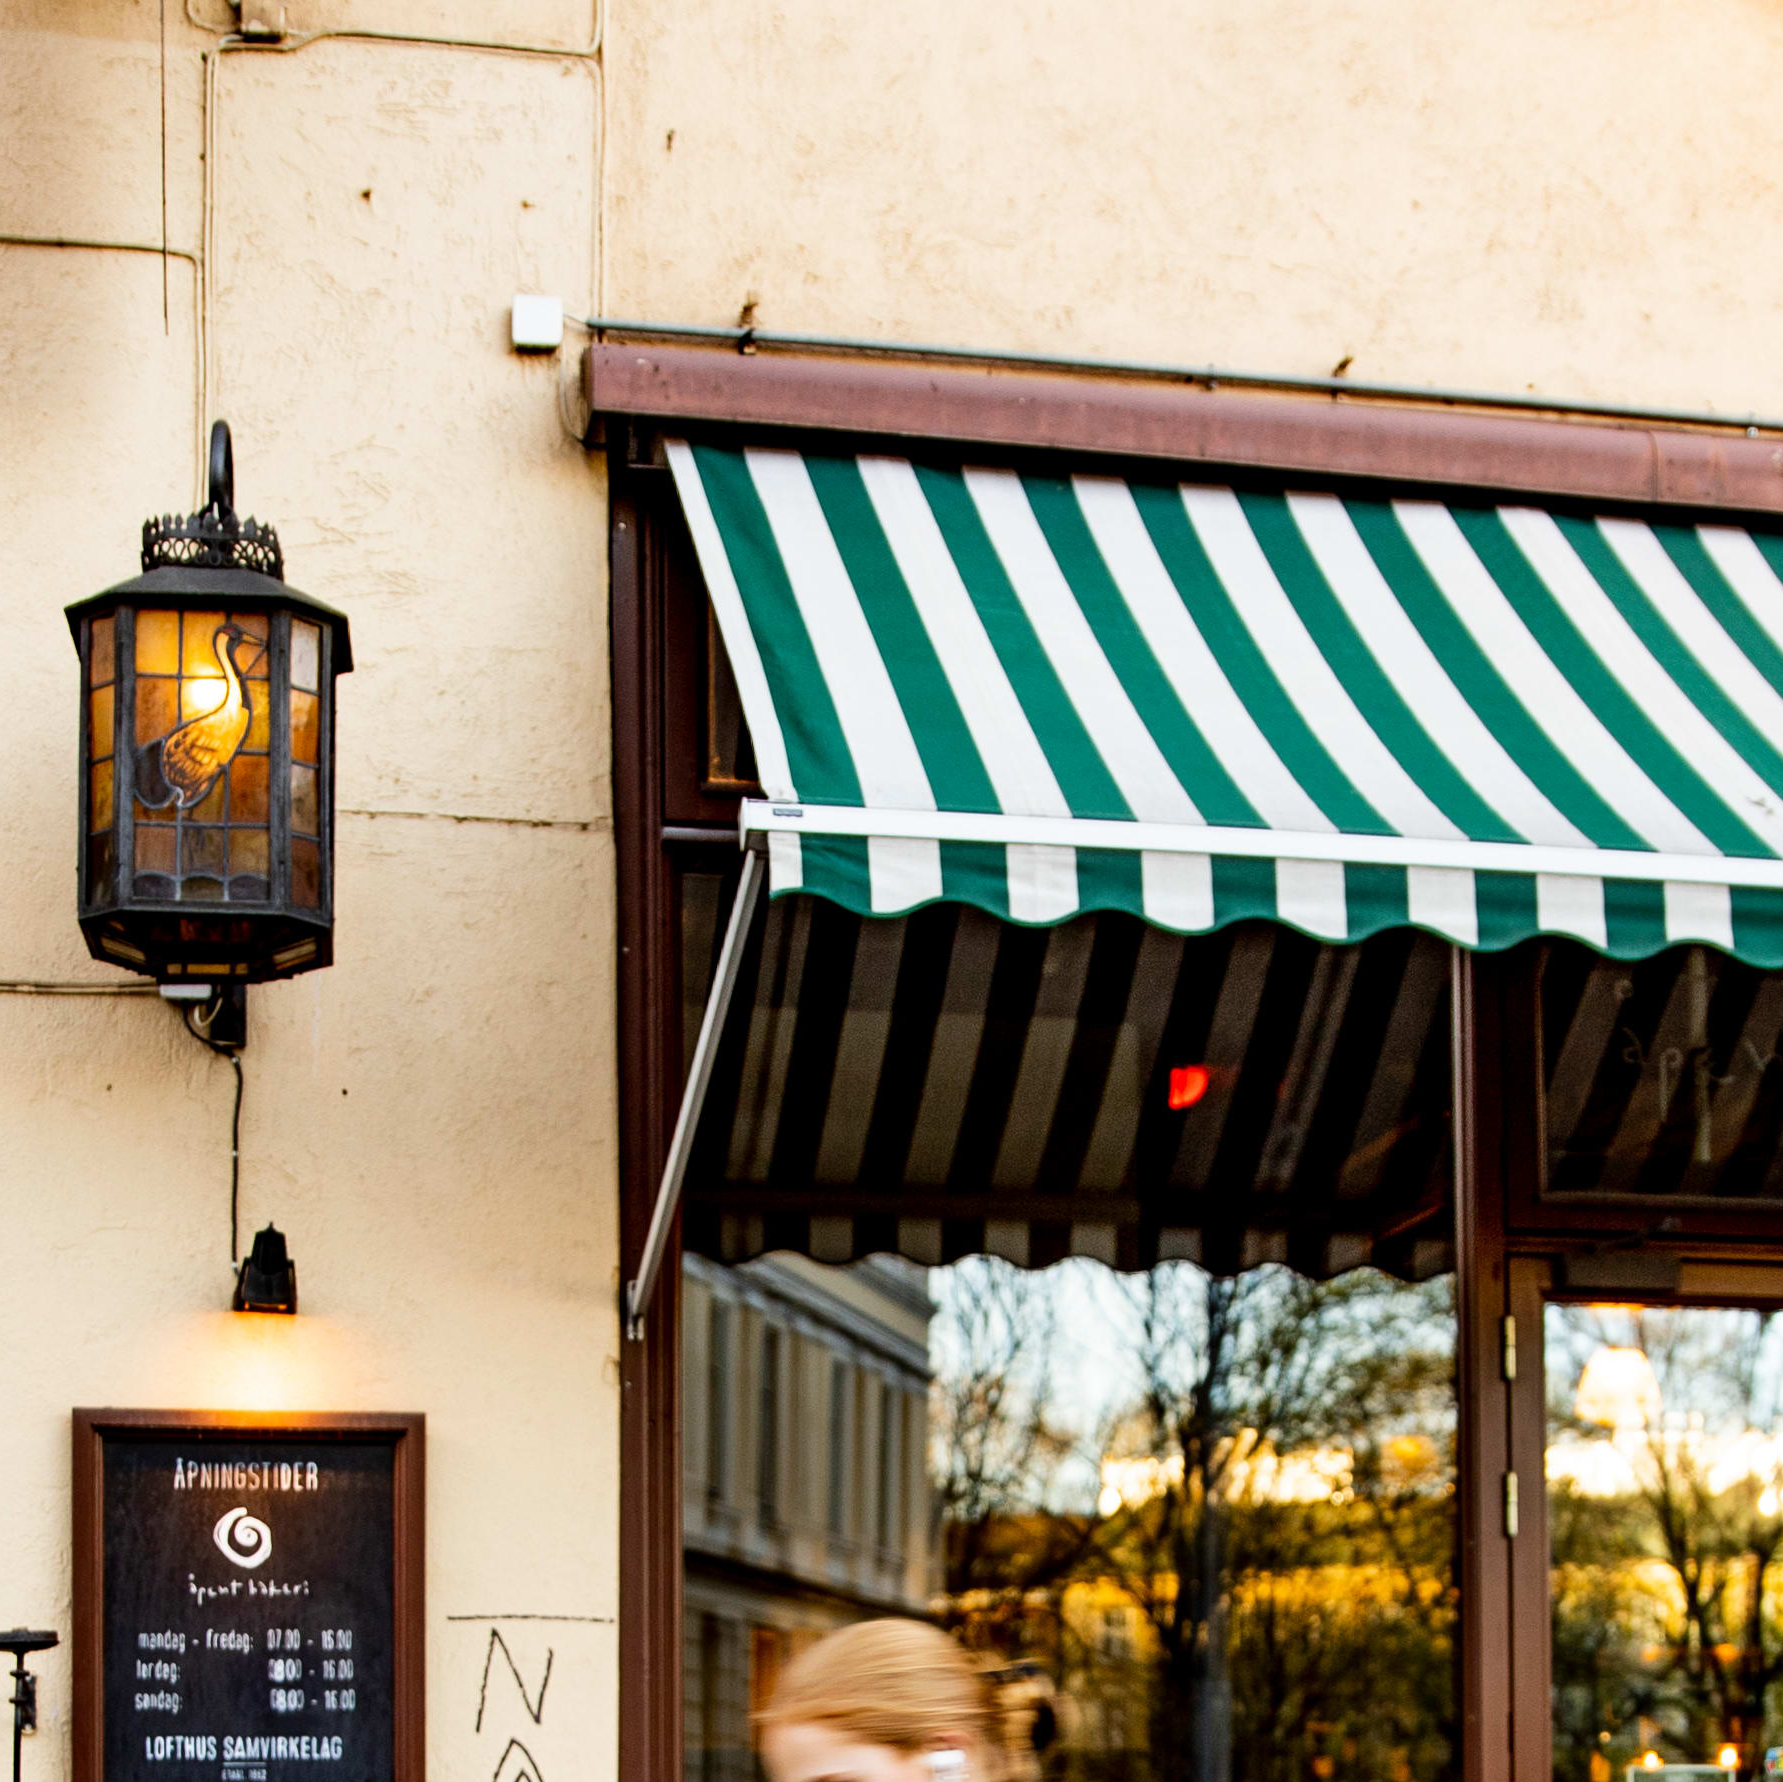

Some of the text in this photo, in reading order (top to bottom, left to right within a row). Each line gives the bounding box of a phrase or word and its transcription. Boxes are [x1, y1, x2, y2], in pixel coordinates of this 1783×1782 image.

[174, 1457, 319, 1491] ÅPNINGSTIDER
[188, 1573, 310, 1606] åpent bakeri
[137, 1629, 187, 1654] mandag
[145, 1735, 344, 1761] LOFTHUS SAMVIRKELAG
